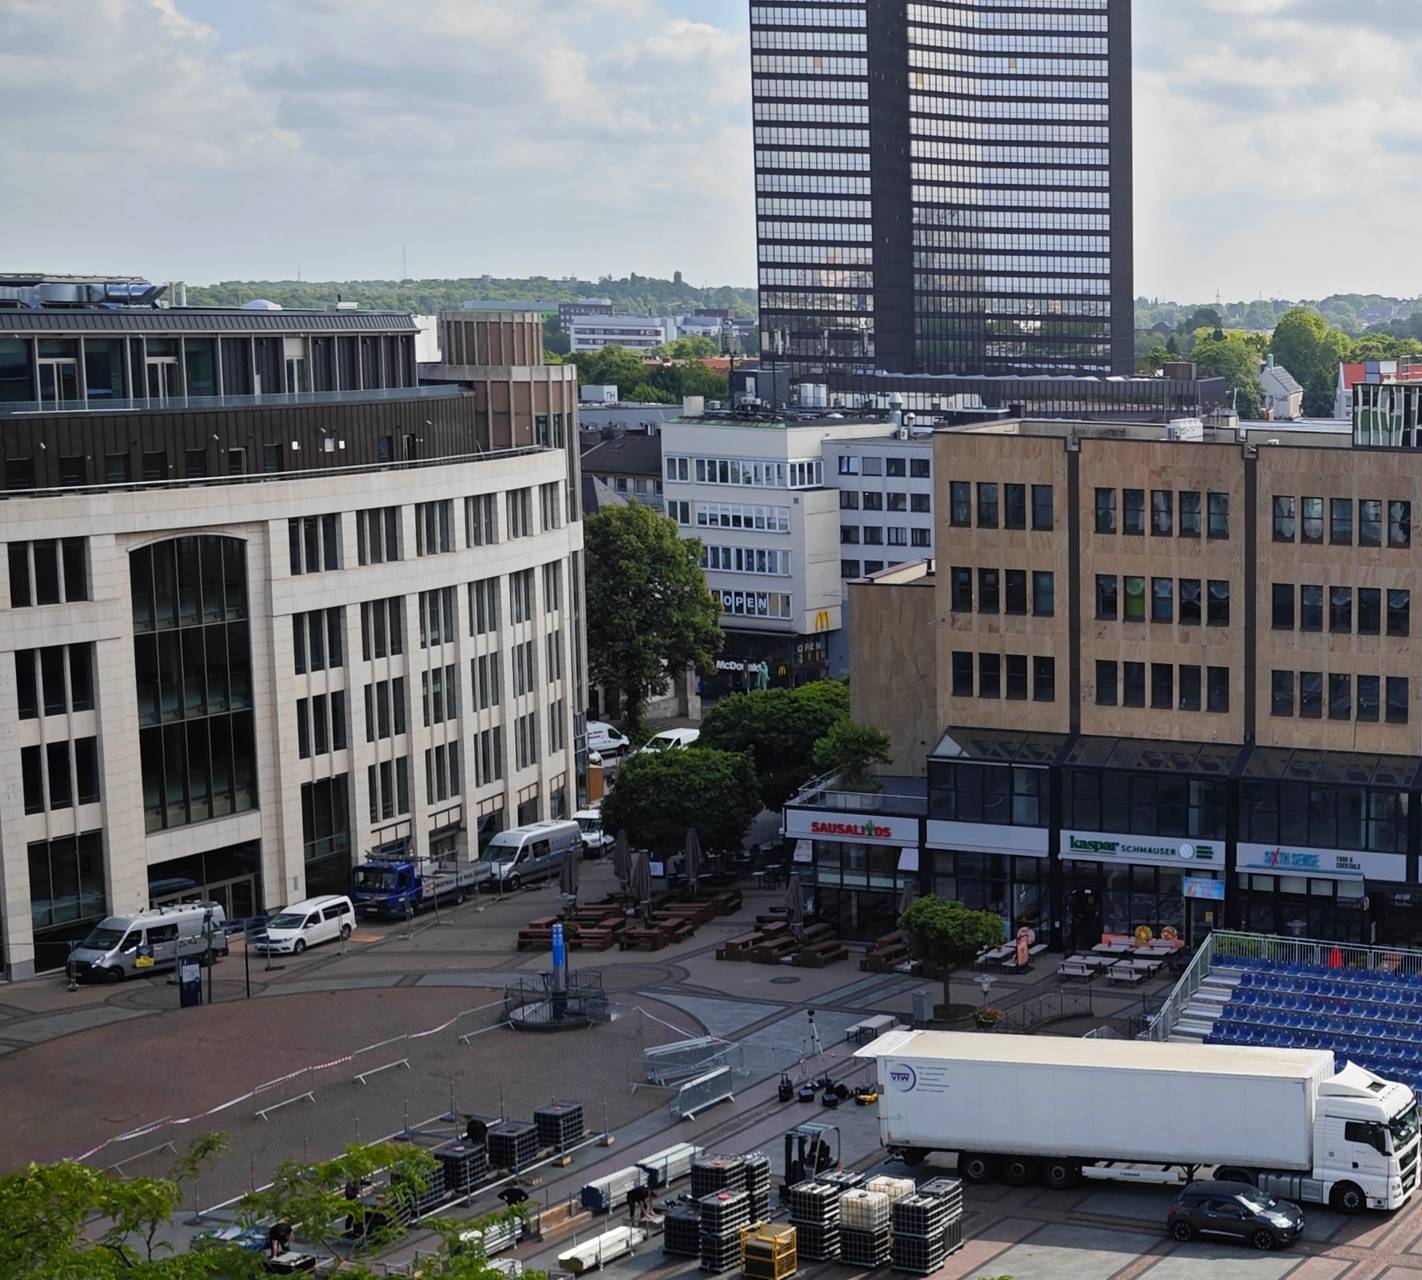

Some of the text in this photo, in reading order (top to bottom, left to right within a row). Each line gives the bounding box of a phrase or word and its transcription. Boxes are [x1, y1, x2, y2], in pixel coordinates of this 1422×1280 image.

[723, 595, 767, 609] OPEN
[797, 641, 822, 653] OPEN
[811, 820, 891, 837] SAUSALITOS
[1069, 835, 1176, 856] kaspar SCHMAUSER
